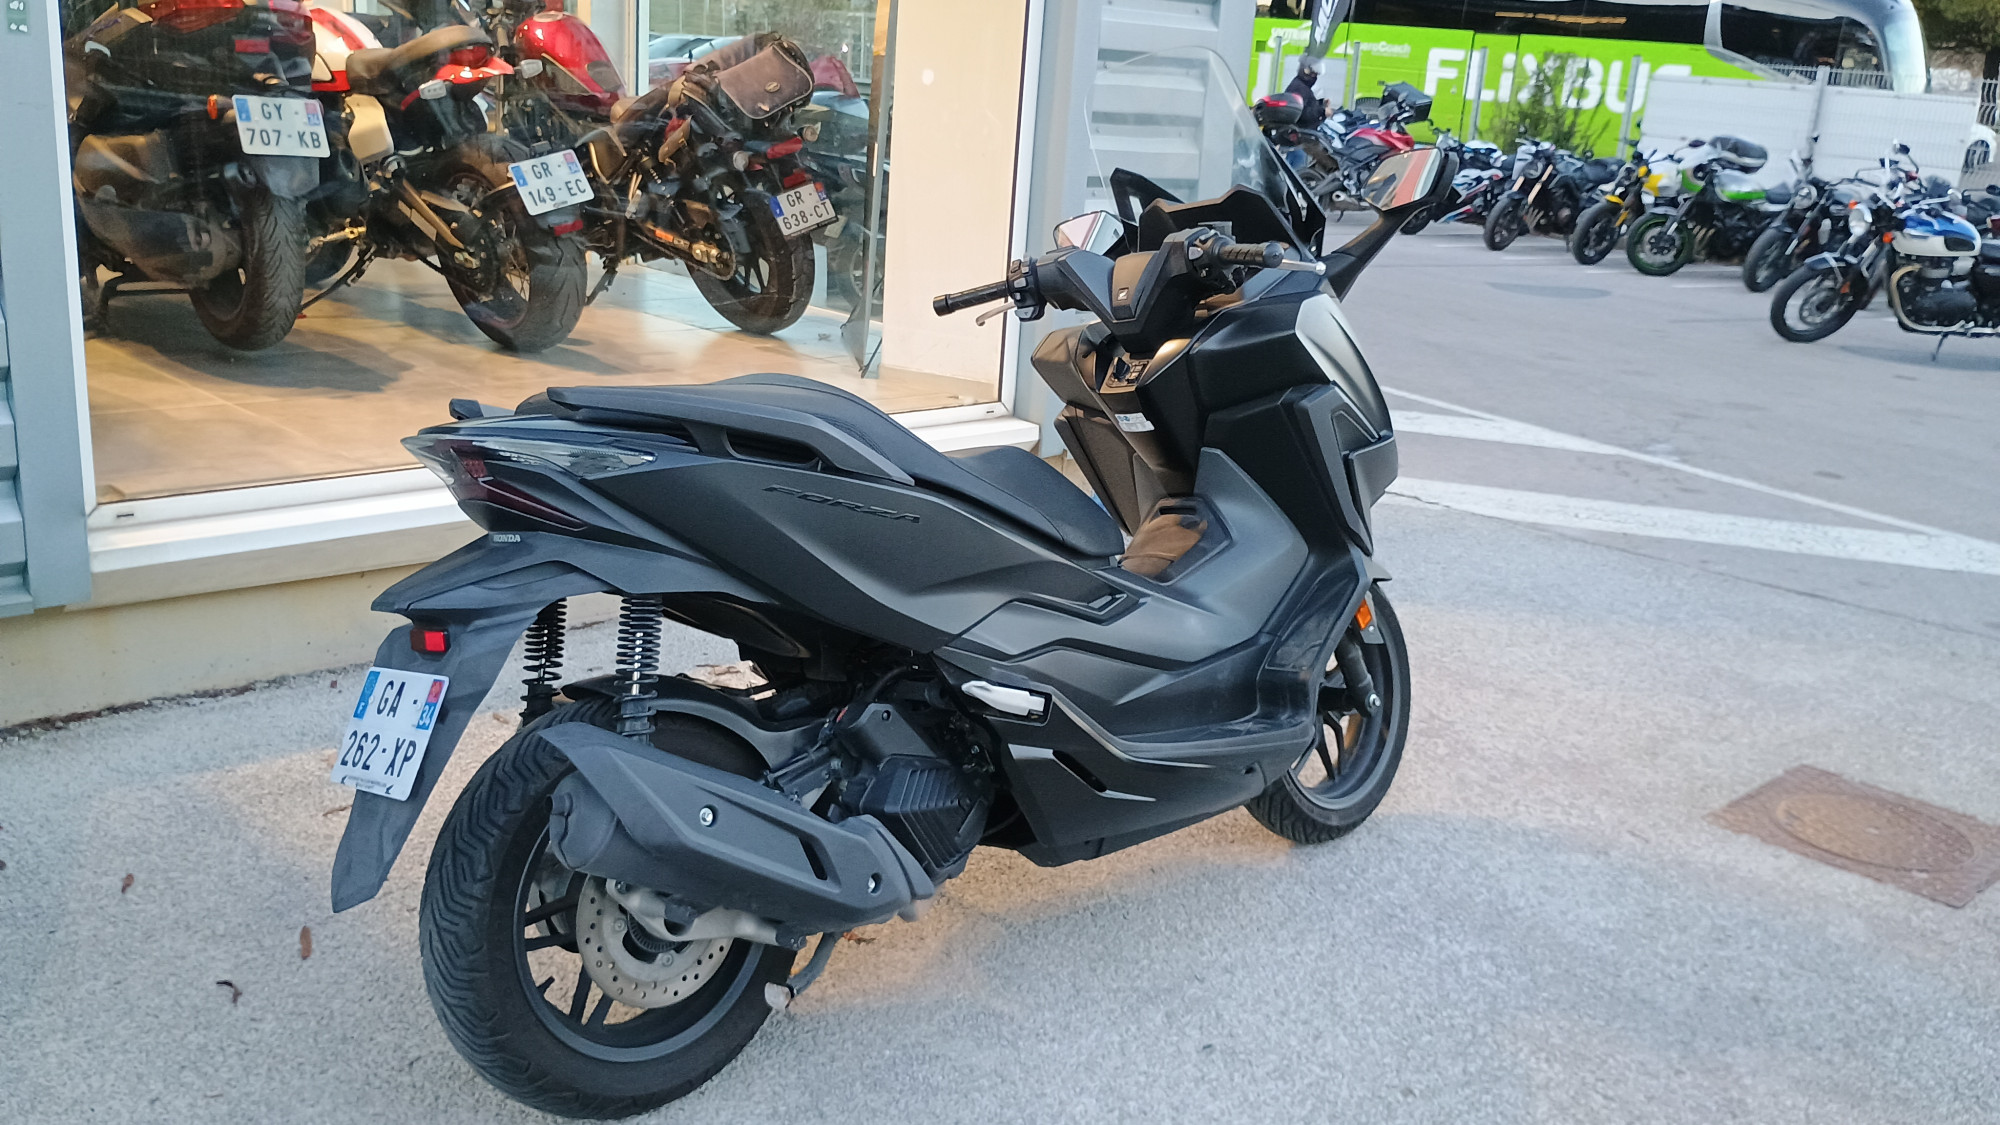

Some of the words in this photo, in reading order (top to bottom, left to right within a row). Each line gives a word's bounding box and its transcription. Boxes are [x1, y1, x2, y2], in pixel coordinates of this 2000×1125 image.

[762, 484, 920, 524] FORZA
[493, 534, 521, 543] HONDA
[418, 704, 435, 727] 34
[340, 729, 417, 778] 262-XP
